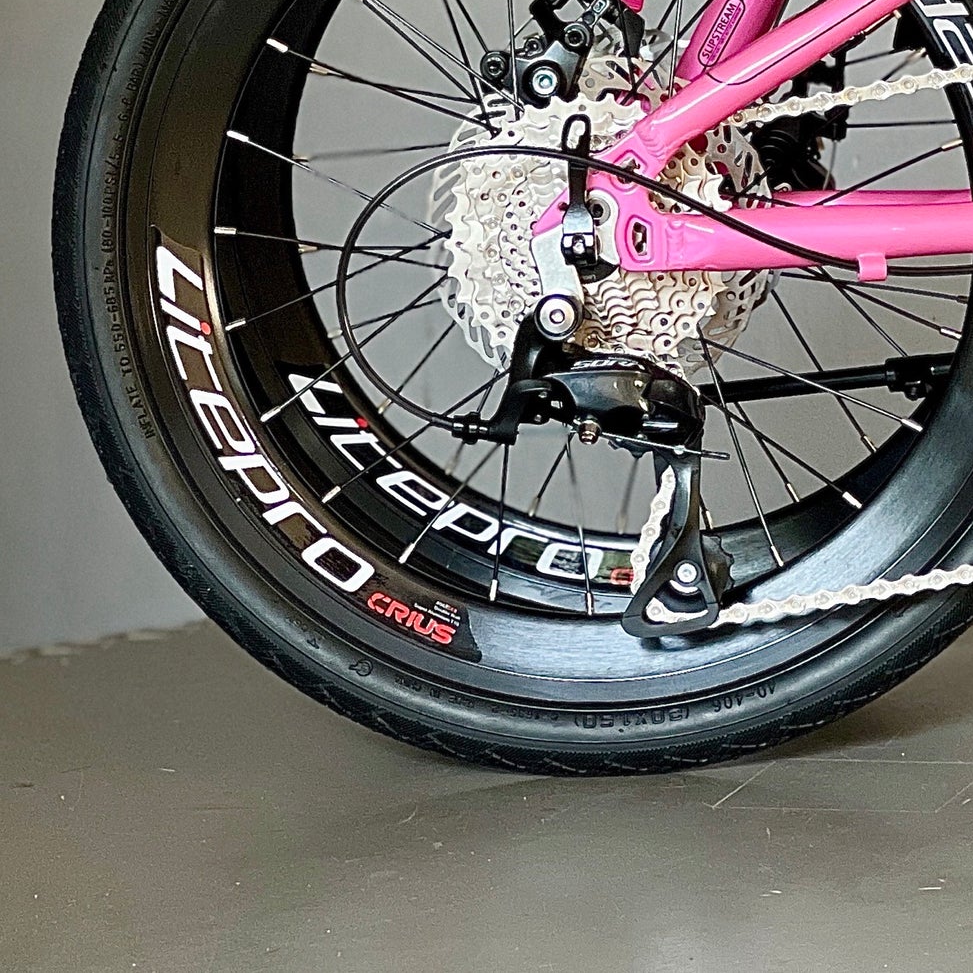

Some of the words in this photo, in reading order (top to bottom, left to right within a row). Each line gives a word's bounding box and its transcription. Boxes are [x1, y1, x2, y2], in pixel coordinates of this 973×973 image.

[701, 2, 737, 60] SLIPSTREAM
[120, 358, 134, 376] TO
[570, 356, 646, 371] SORA
[124, 385, 156, 440] INFLATE
[367, 592, 456, 645] CRIUS
[713, 682, 777, 712] 40-406
